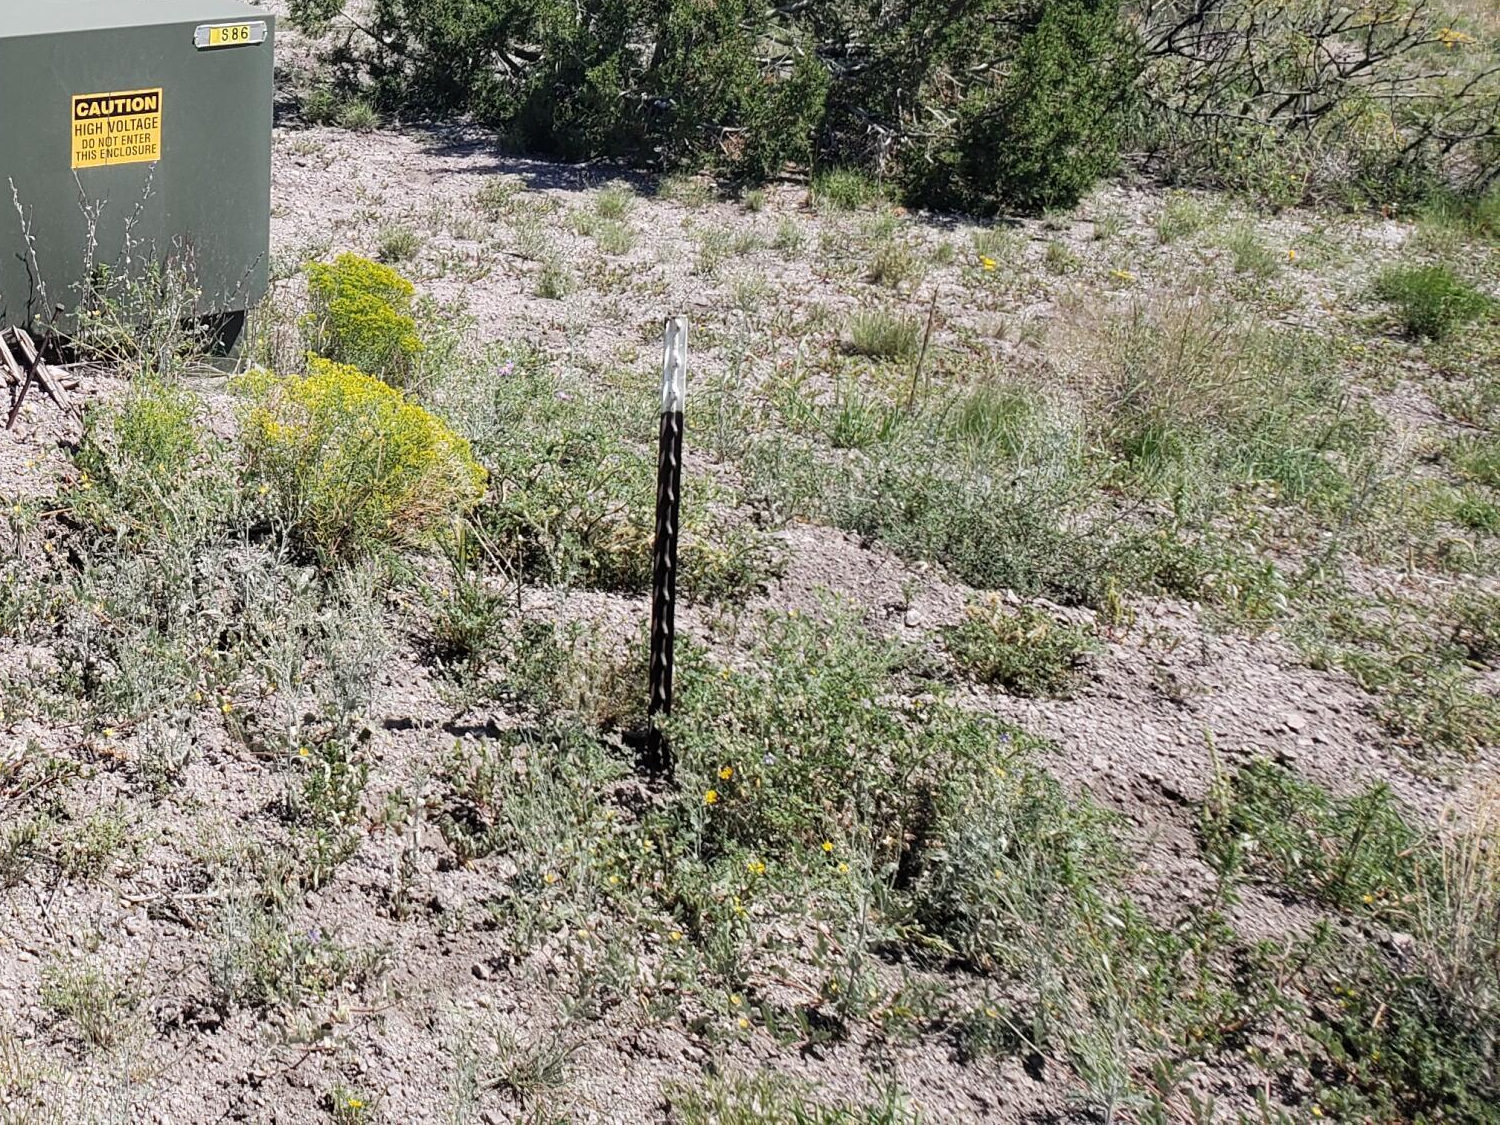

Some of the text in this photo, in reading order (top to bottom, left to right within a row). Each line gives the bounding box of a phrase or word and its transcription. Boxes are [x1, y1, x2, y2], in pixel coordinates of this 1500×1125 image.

[221, 26, 248, 41] S86
[76, 95, 157, 117] CAUTION
[74, 116, 158, 137] HIGH VOLTAGE
[82, 132, 151, 149] DO NOT ENTER
[76, 143, 157, 162] THIS ENCLOSURE
